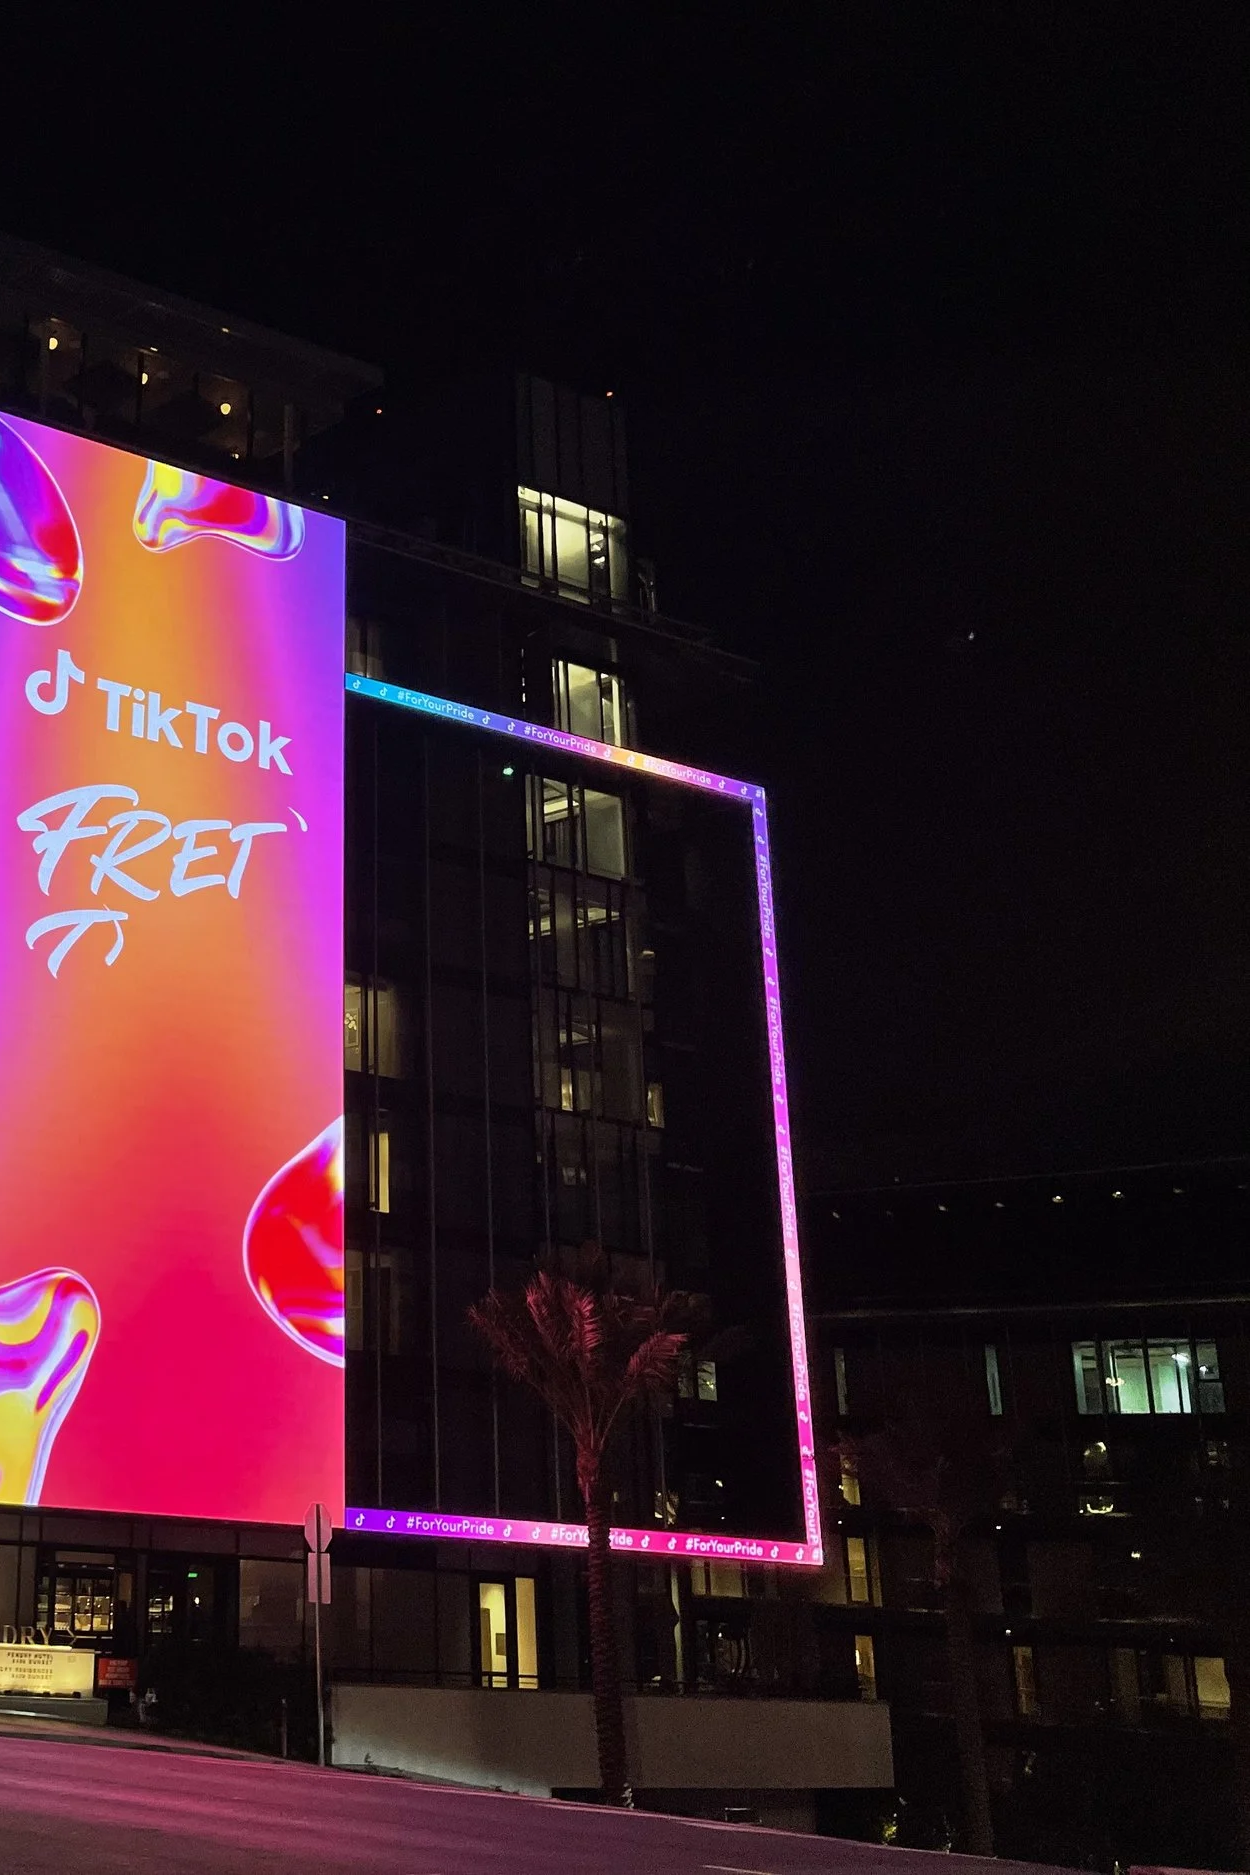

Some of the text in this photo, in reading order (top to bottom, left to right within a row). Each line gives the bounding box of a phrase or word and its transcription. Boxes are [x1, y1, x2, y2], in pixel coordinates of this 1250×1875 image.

[398, 690, 474, 720] #ForYourPride
[97, 678, 293, 775] TikTok
[524, 725, 597, 753] #ForYourPride
[406, 1515, 494, 1535] #ForYourPride
[685, 1537, 763, 1556] #ForYourPride
